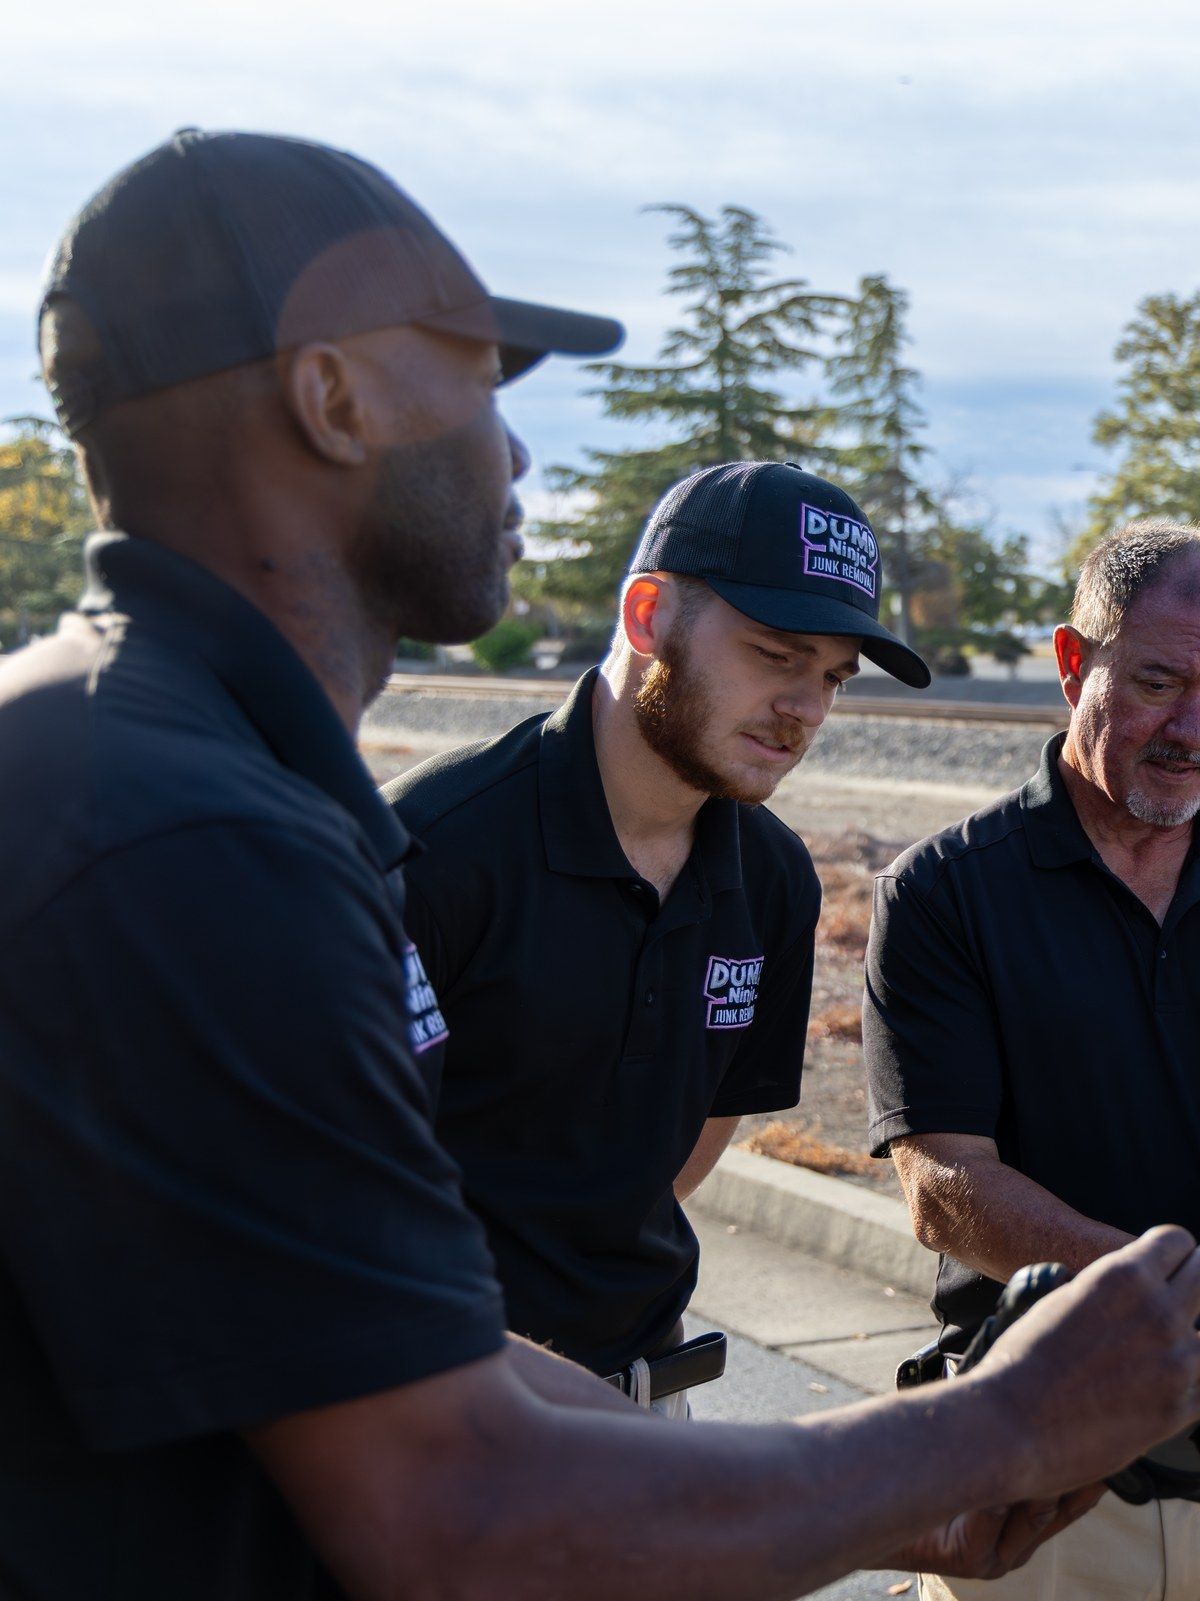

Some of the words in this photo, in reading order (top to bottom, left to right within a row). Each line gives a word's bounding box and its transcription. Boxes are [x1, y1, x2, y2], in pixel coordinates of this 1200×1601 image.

[828, 537, 868, 569] Ninja
[811, 556, 840, 575] JUNK
[842, 562, 873, 591] REMOVAL
[710, 962, 763, 990] DUM
[714, 1009, 737, 1024] JUNK
